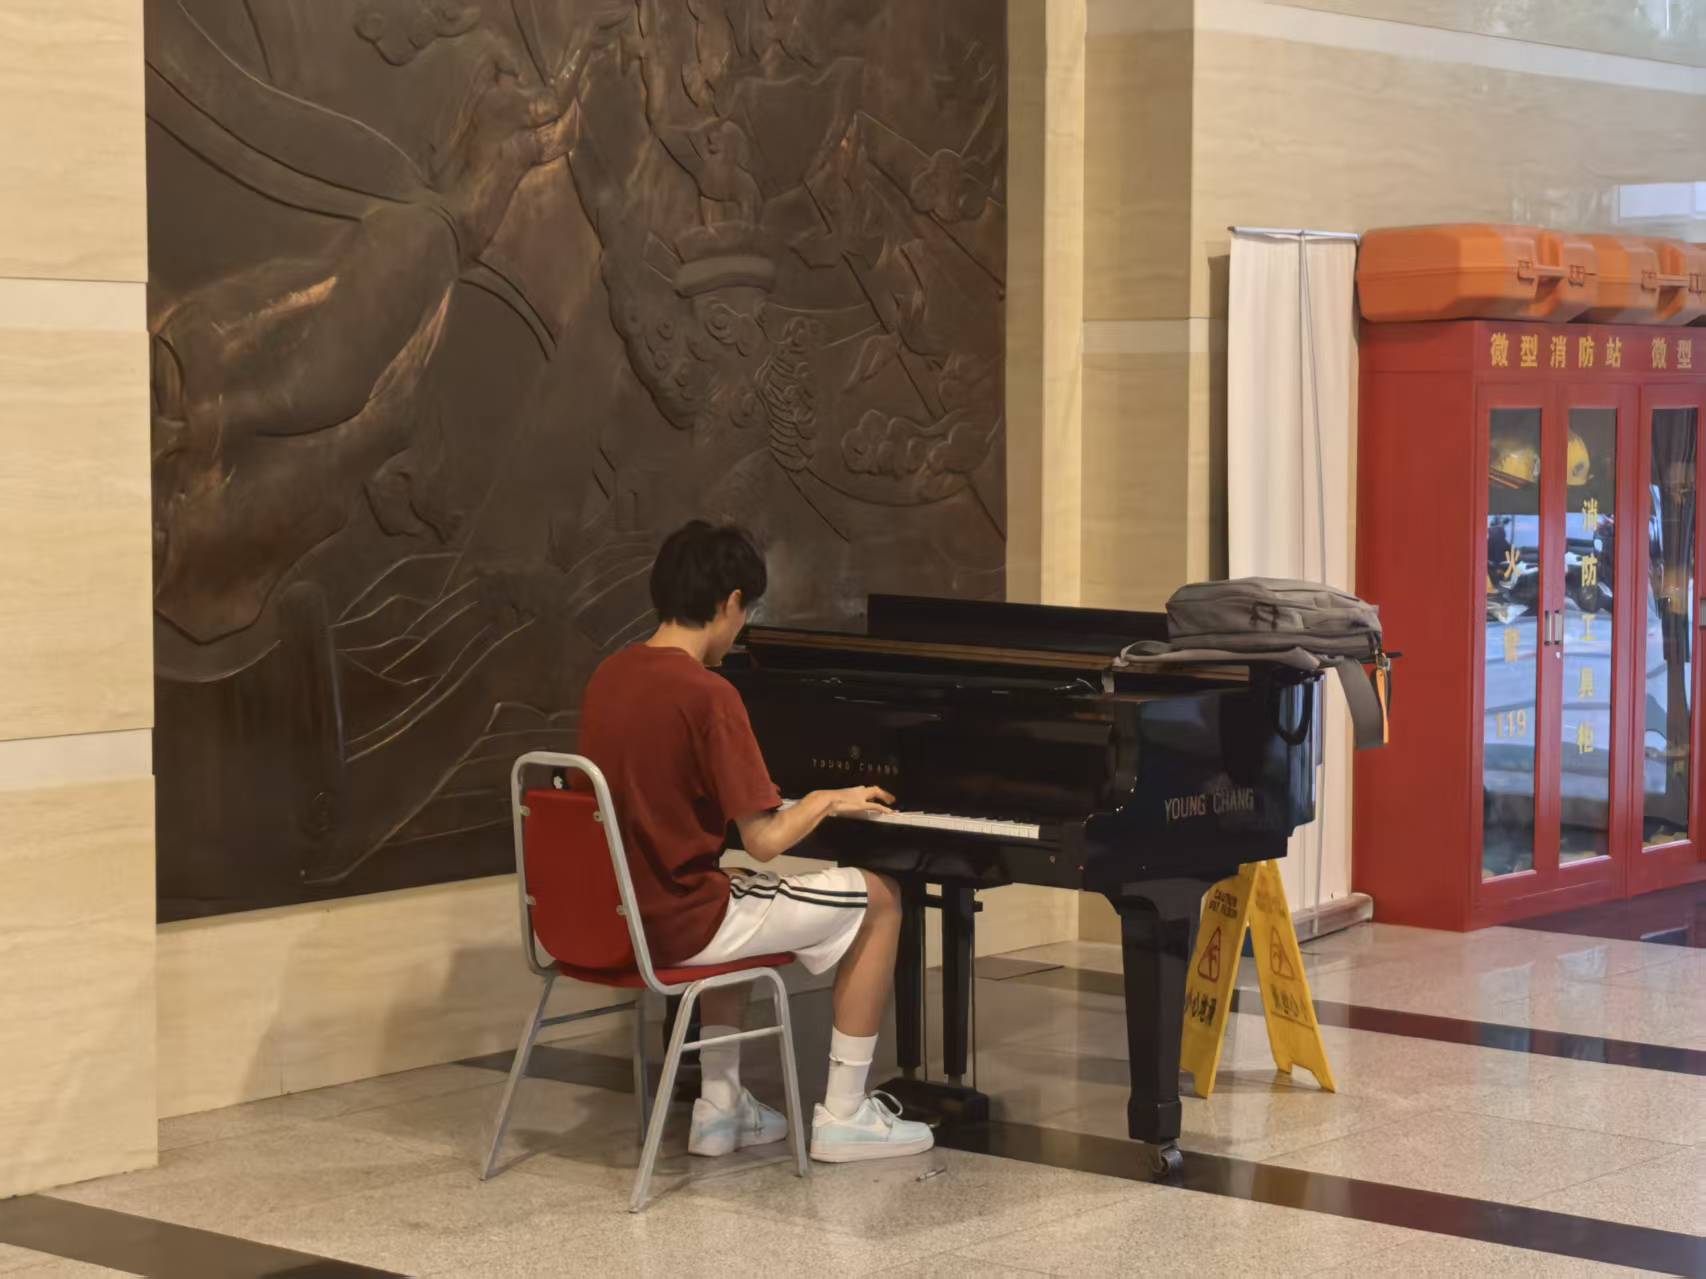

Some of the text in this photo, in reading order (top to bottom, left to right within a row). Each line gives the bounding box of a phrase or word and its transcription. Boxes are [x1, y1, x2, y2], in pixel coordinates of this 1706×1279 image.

[1490, 332, 1623, 369] 微型消防站
[1651, 336, 1693, 369] 微型
[1164, 786, 1255, 824] YOUNG CHANG
